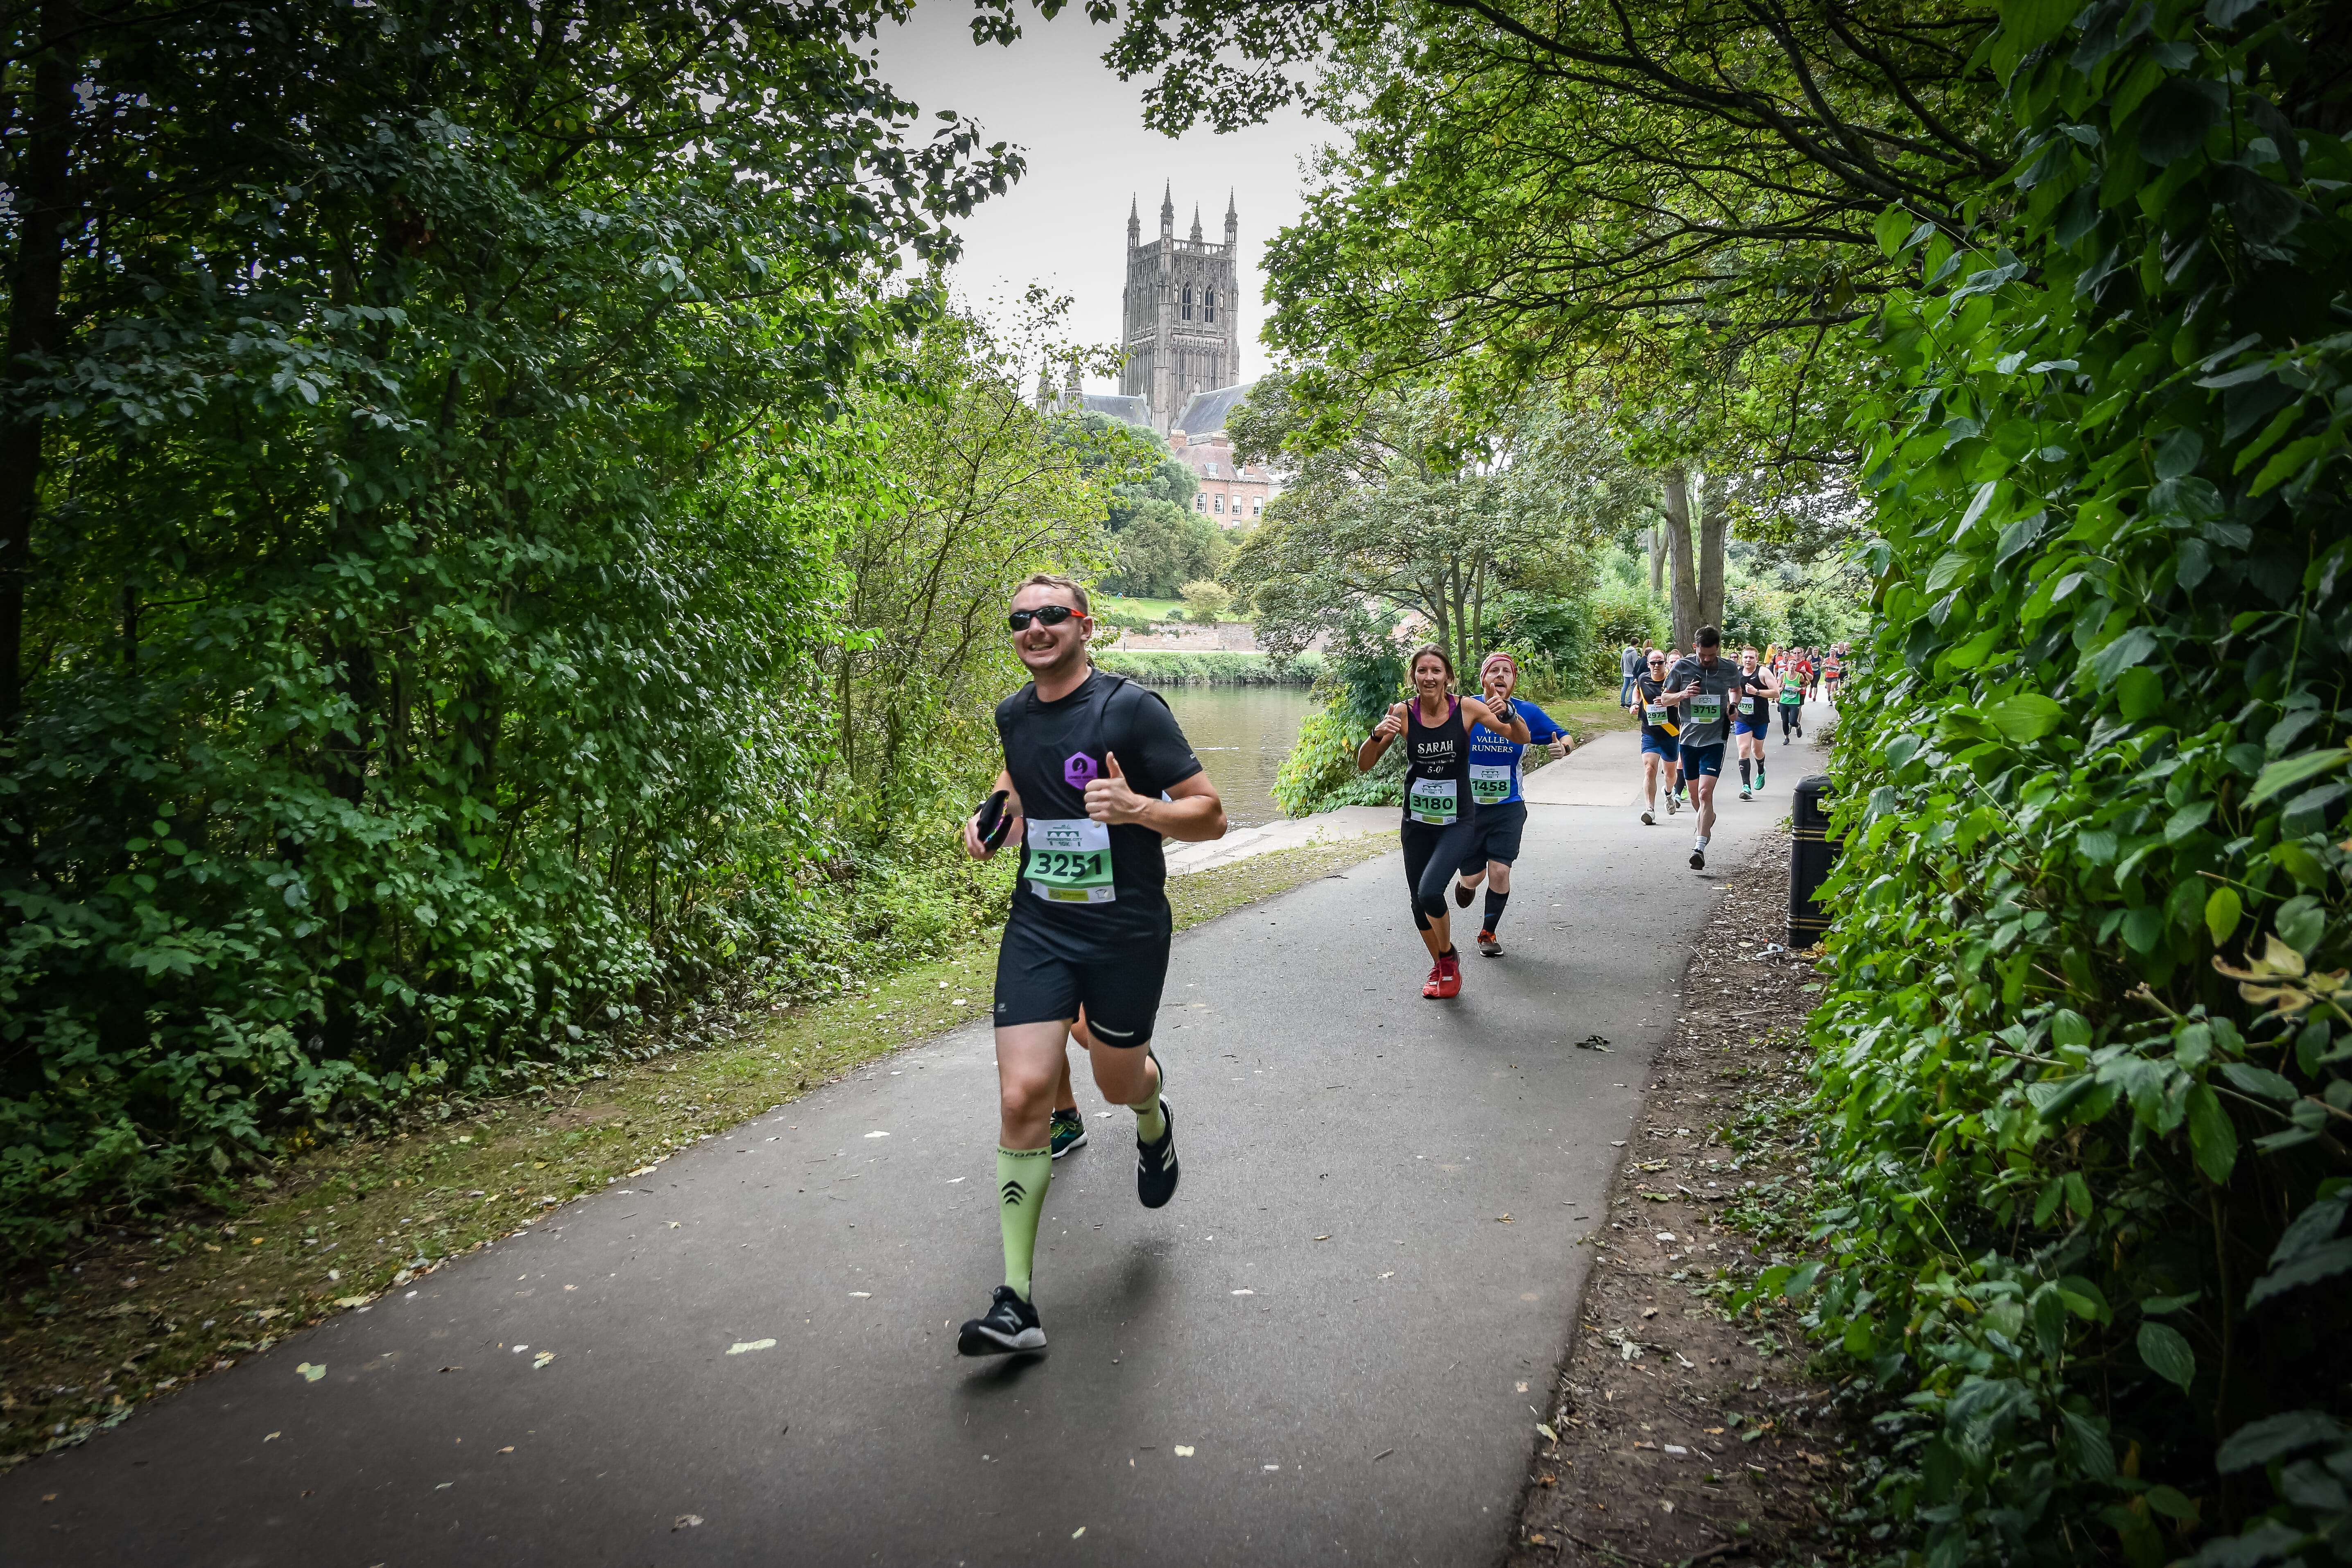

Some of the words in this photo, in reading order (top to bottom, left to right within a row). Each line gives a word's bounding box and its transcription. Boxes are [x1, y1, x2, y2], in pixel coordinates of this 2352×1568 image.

[1476, 736, 1509, 744] VALLEY
[1418, 740, 1453, 754] SARAH
[1472, 744, 1513, 753] RUNNERS
[1471, 780, 1507, 792] 1458
[1413, 795, 1453, 810] 3180
[1034, 853, 1102, 877] 3251
